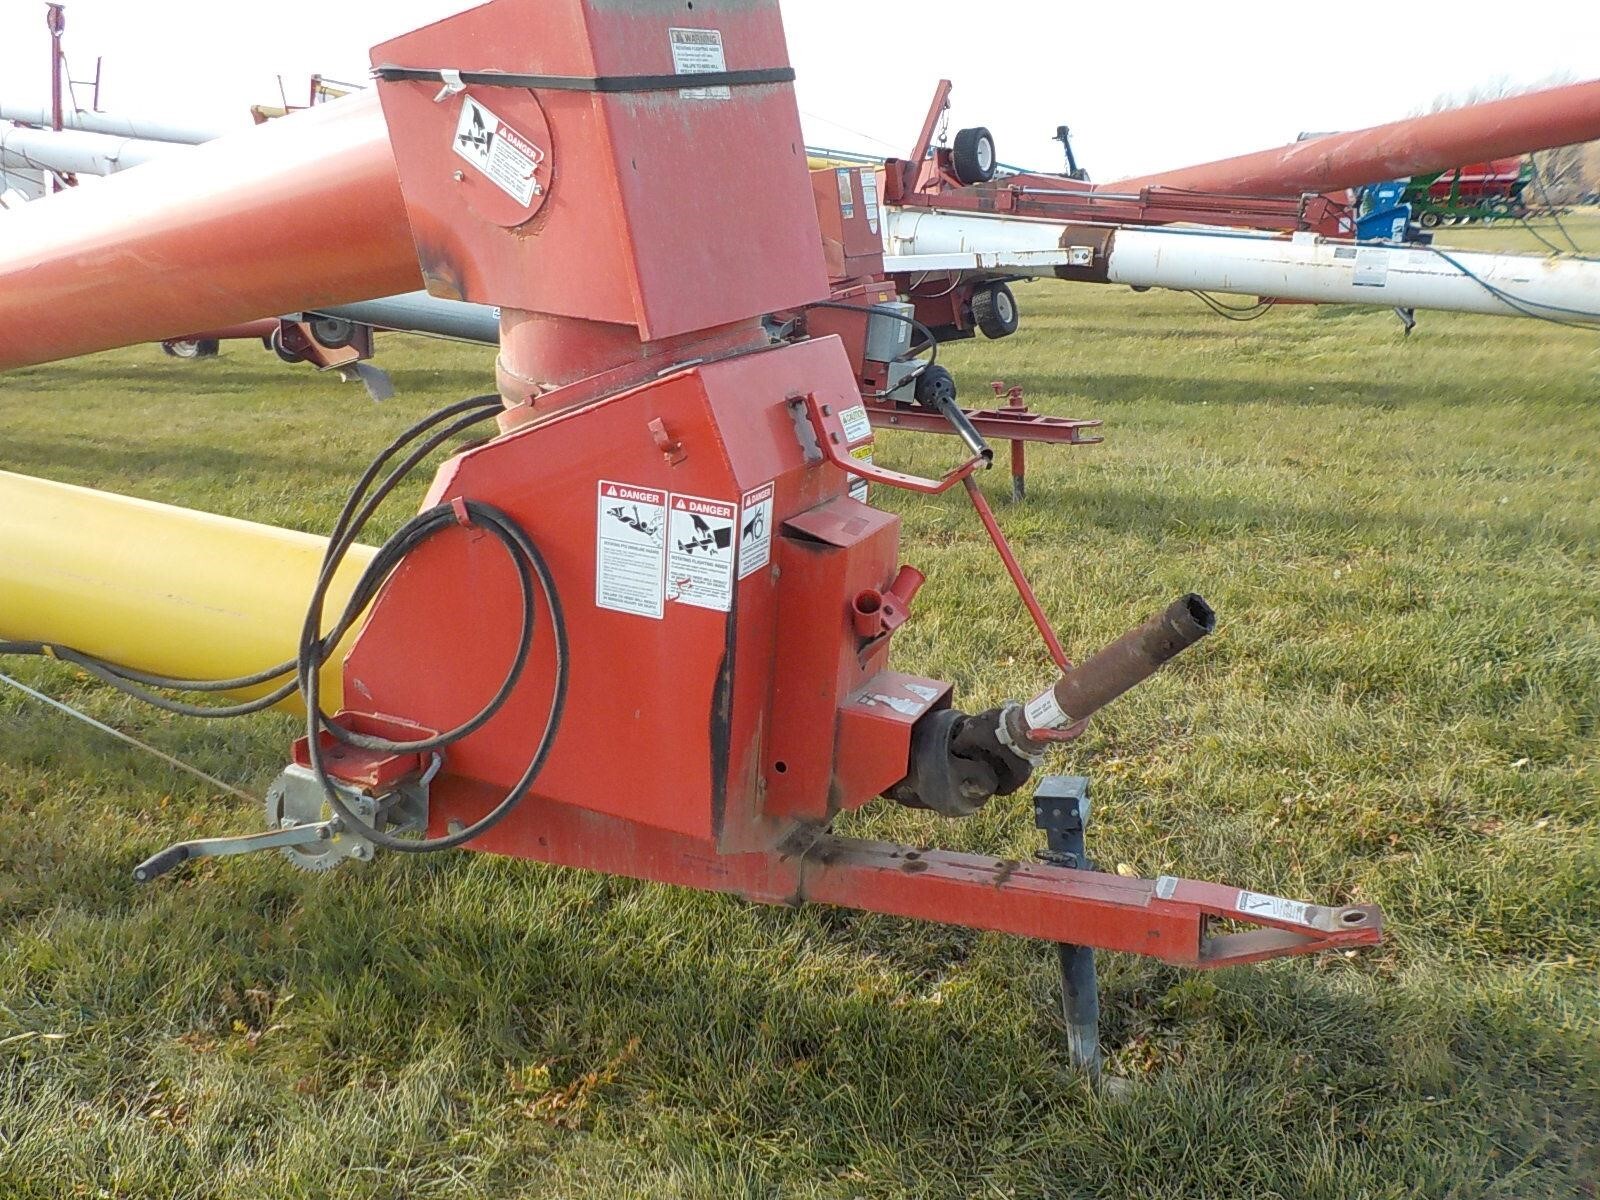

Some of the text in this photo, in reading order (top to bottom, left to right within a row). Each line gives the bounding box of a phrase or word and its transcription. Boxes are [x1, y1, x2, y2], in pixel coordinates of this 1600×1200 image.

[507, 133, 536, 160] DANGER
[620, 489, 660, 503] DANGER
[752, 488, 770, 503] DANGER
[689, 502, 730, 516] DANGER
